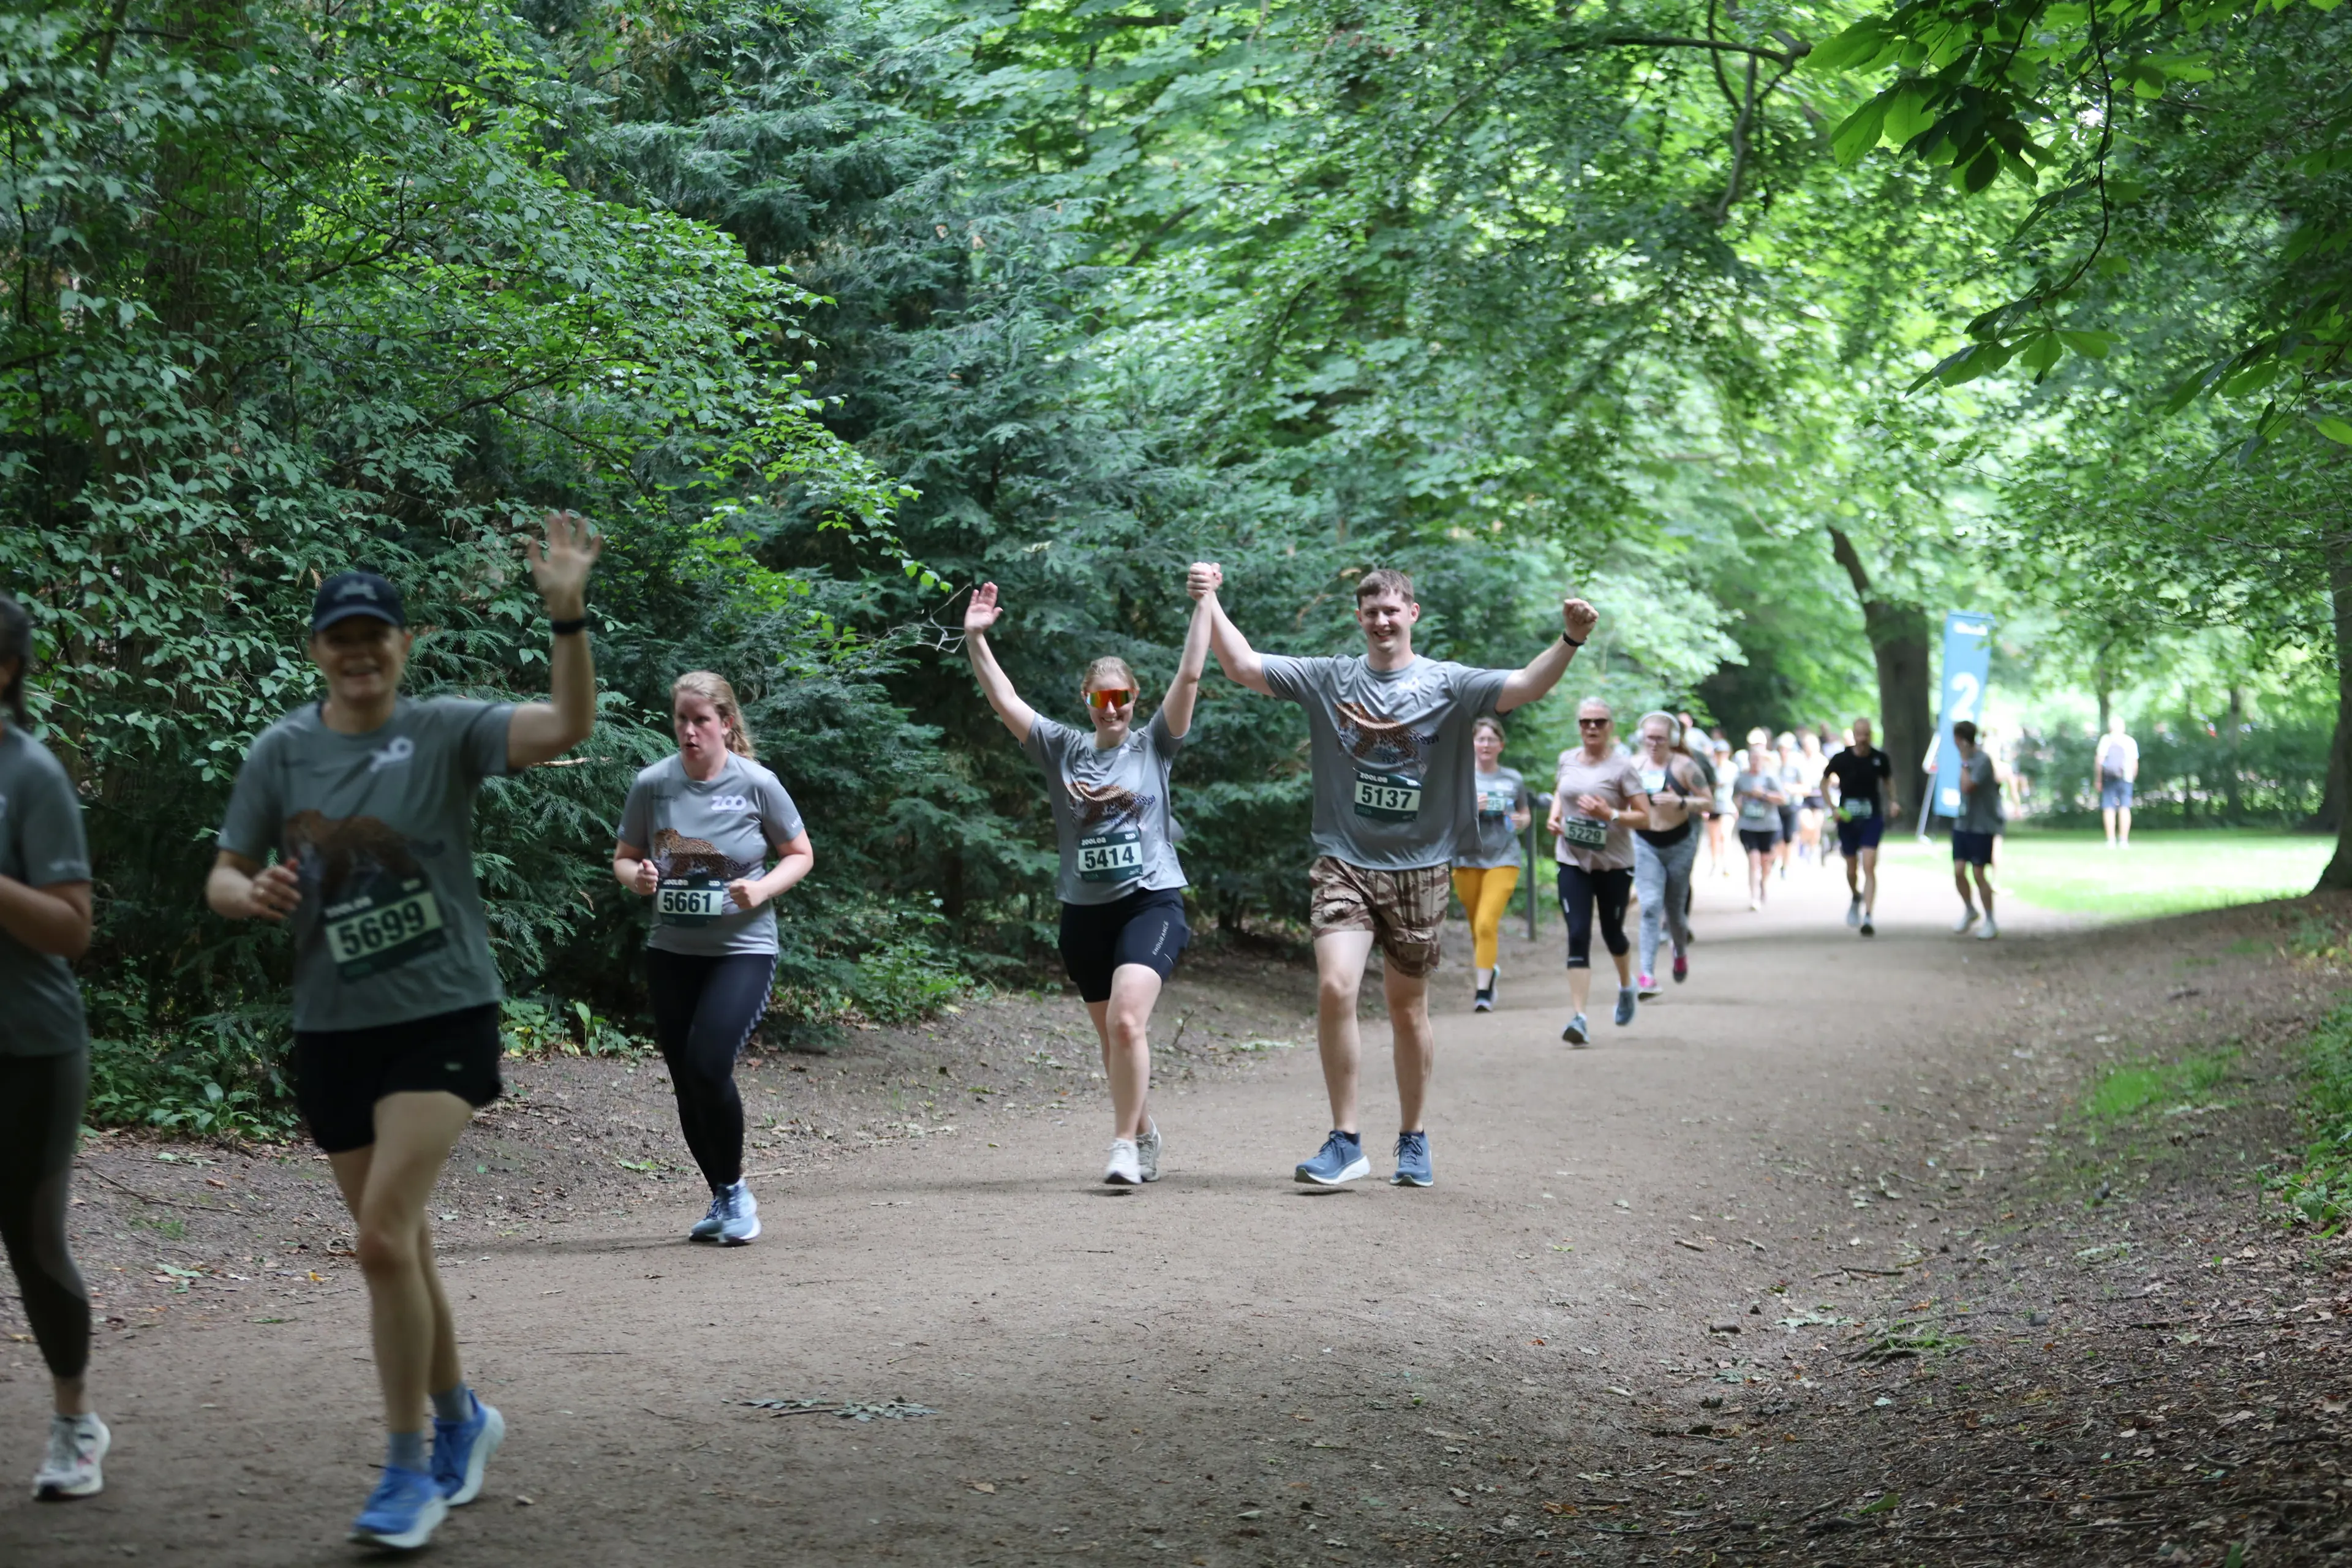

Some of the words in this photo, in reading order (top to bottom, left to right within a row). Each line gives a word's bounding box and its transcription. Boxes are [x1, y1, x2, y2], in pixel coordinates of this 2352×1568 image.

[1948, 672, 1979, 722] 2
[711, 795, 747, 811] ZOO
[1362, 785, 1412, 809] 5137
[1569, 826, 1601, 842] 5229
[1085, 846, 1134, 869] 5414
[663, 892, 710, 913] 5661
[338, 900, 426, 956] 5699
[1152, 920, 1169, 956] ENDURANCE
